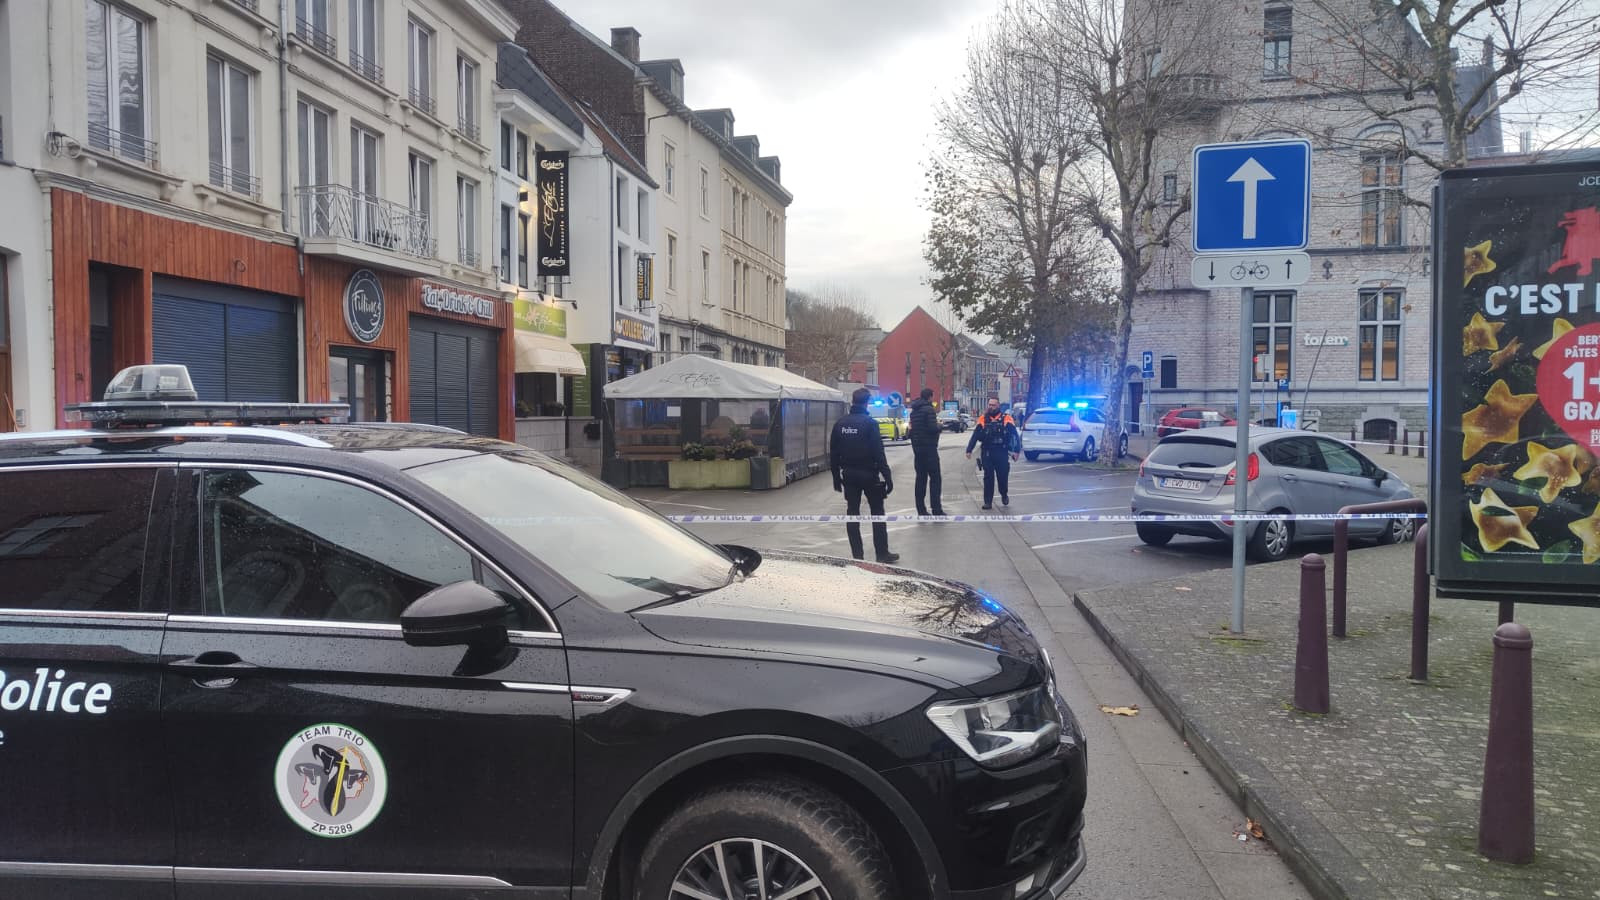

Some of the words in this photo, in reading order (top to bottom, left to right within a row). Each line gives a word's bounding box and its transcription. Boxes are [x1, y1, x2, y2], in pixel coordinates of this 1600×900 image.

[1485, 282, 1585, 316] C'EST
[1578, 335, 1600, 345] BER
[1564, 345, 1598, 358] PÂTES
[1143, 354, 1152, 369] P
[841, 426, 858, 435] Police
[298, 726, 331, 743] TEAM
[338, 727, 364, 747] TRIO
[311, 822, 327, 833] ZP
[328, 823, 353, 835] 5289
